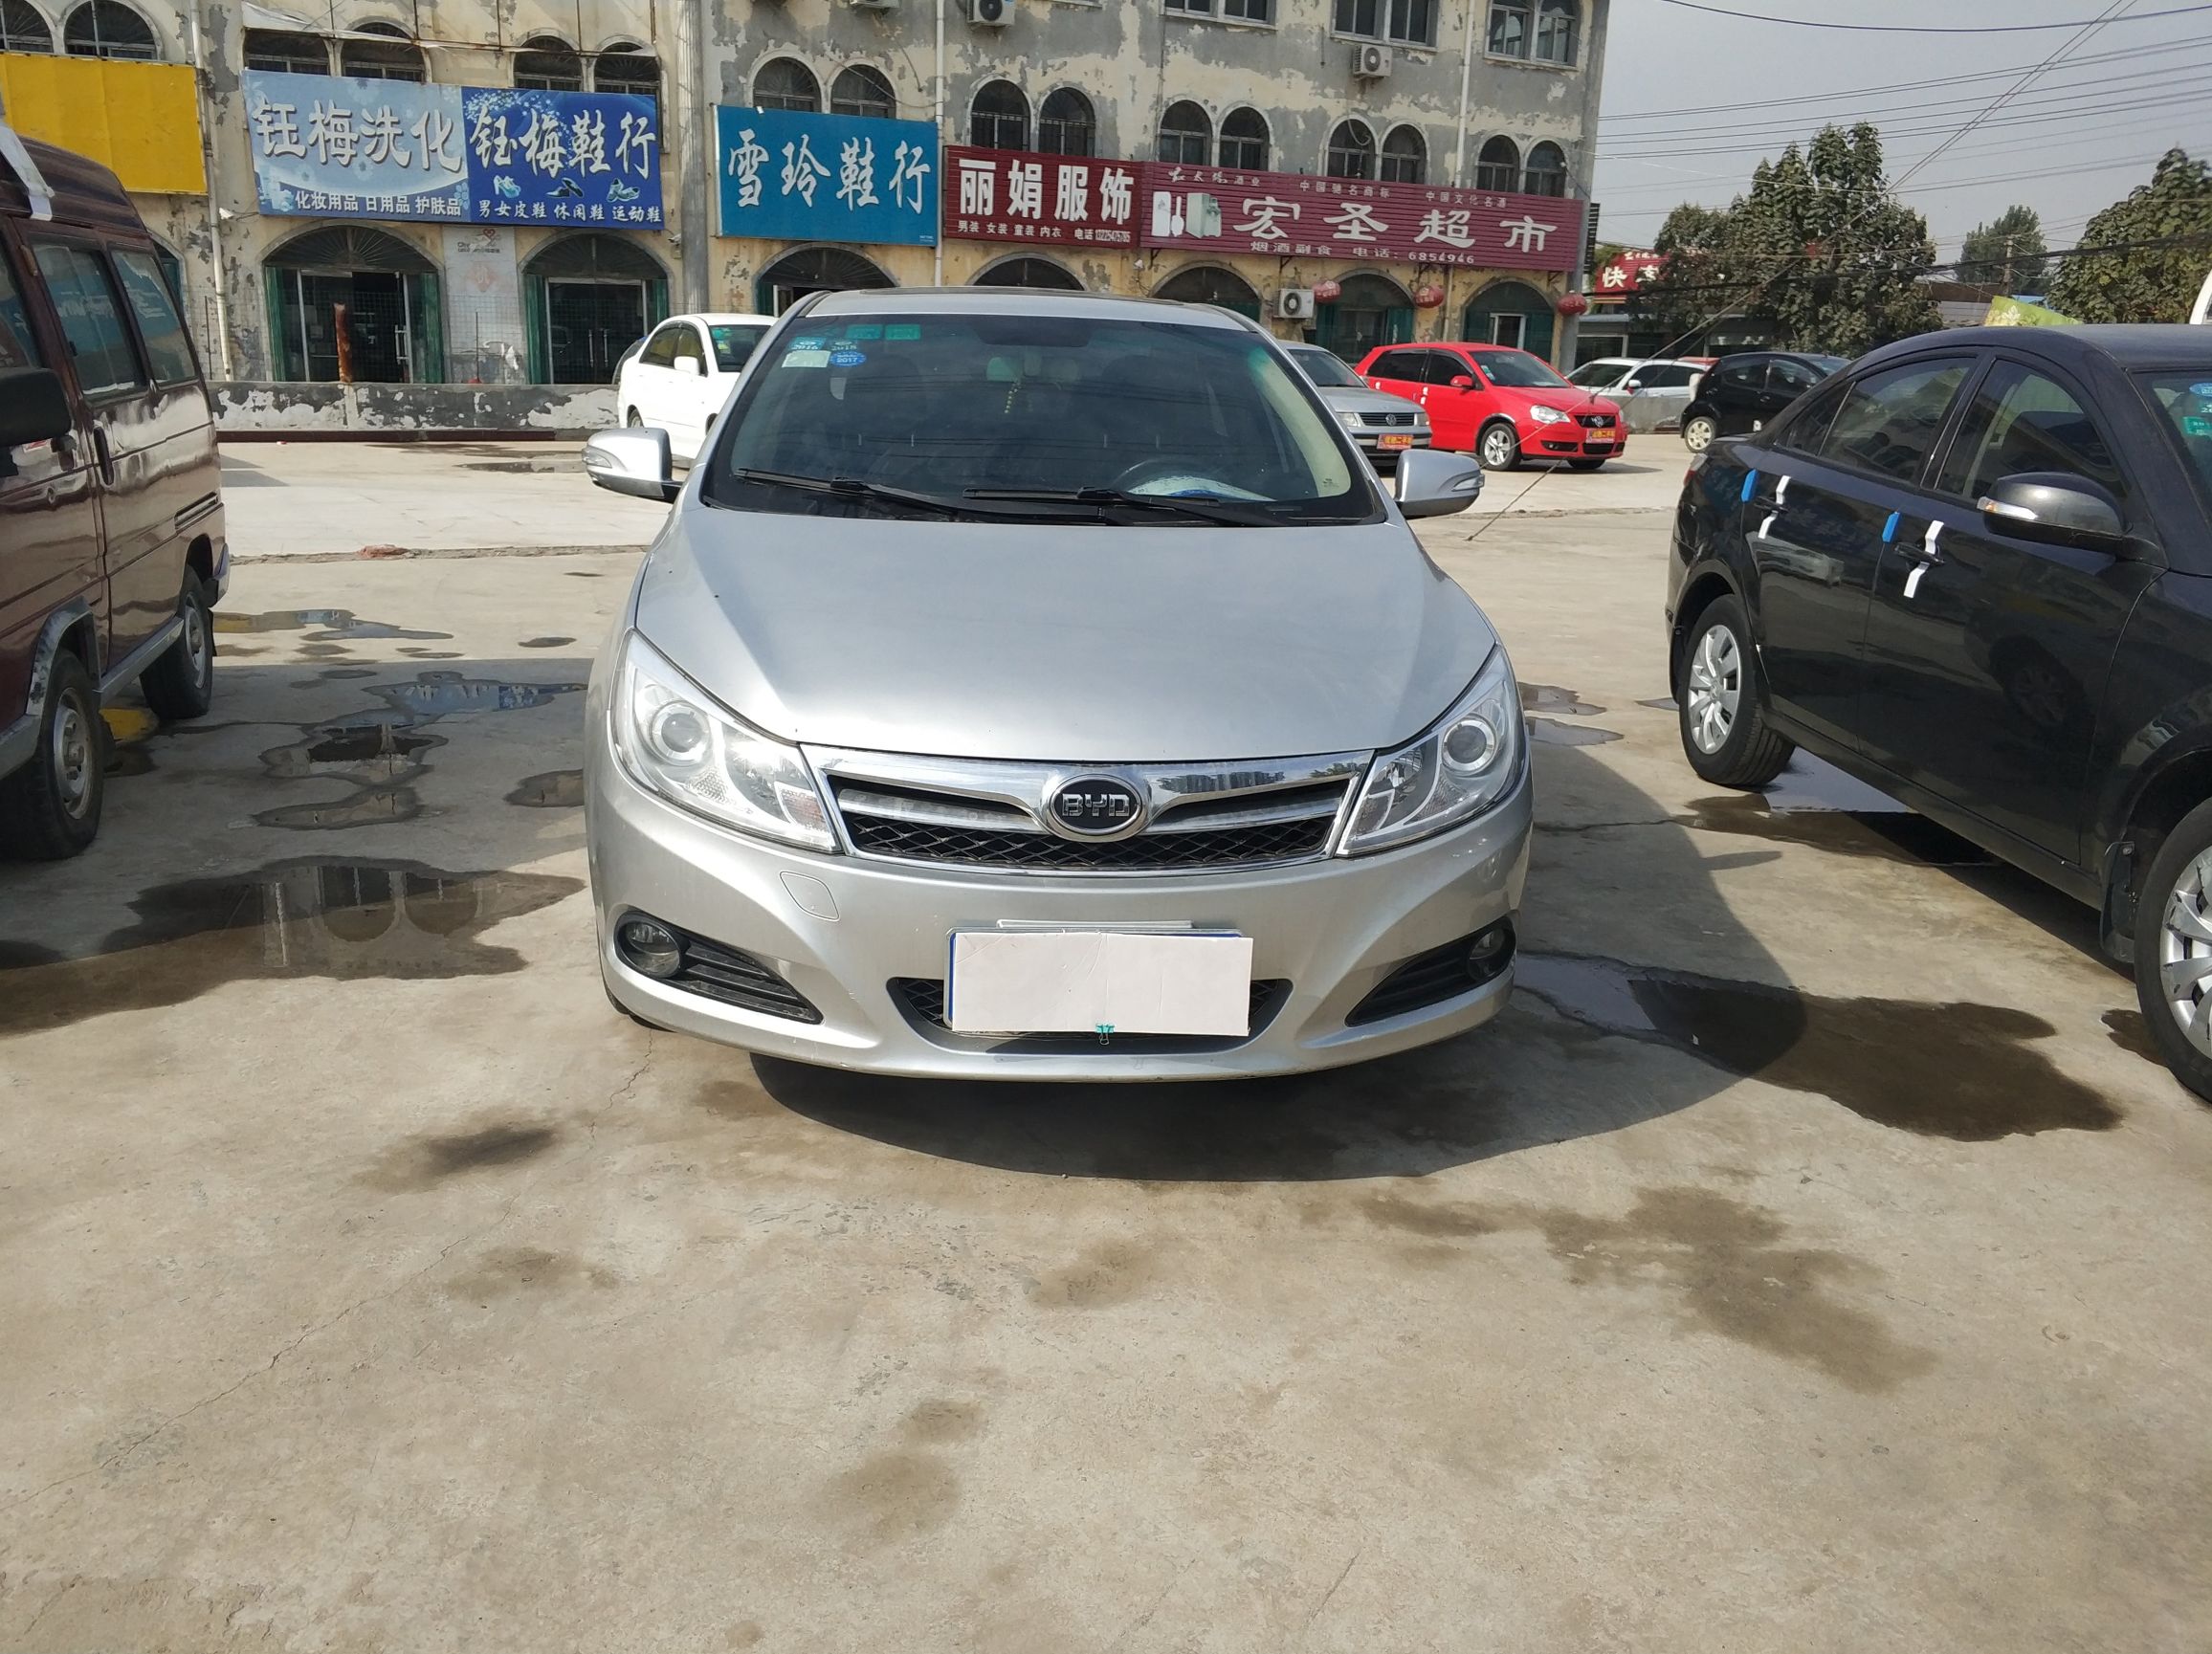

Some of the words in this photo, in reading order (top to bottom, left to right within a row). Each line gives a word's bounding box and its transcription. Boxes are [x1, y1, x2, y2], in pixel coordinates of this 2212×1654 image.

[252, 99, 462, 174] 钰梅洗化
[469, 107, 657, 180] 钰梅鞋行
[728, 128, 932, 214] 雪玲鞋行
[295, 190, 359, 212] 化妆用品
[365, 194, 410, 213] 日用品
[415, 197, 461, 216] 护肤品
[478, 200, 547, 218] 男女皮鞋
[553, 204, 605, 221] 休闲鞋
[611, 206, 662, 223] 运动鞋
[959, 158, 1136, 226] 丽娟服饰
[958, 220, 980, 232] 男装
[986, 223, 1008, 235] 女装
[1014, 224, 1035, 237] 童装
[1039, 226, 1062, 238] 内衣
[1232, 196, 1559, 253] 宏圣超市
[1250, 241, 1333, 256] 烟酒副食
[1062, 793, 1130, 817] BYD
